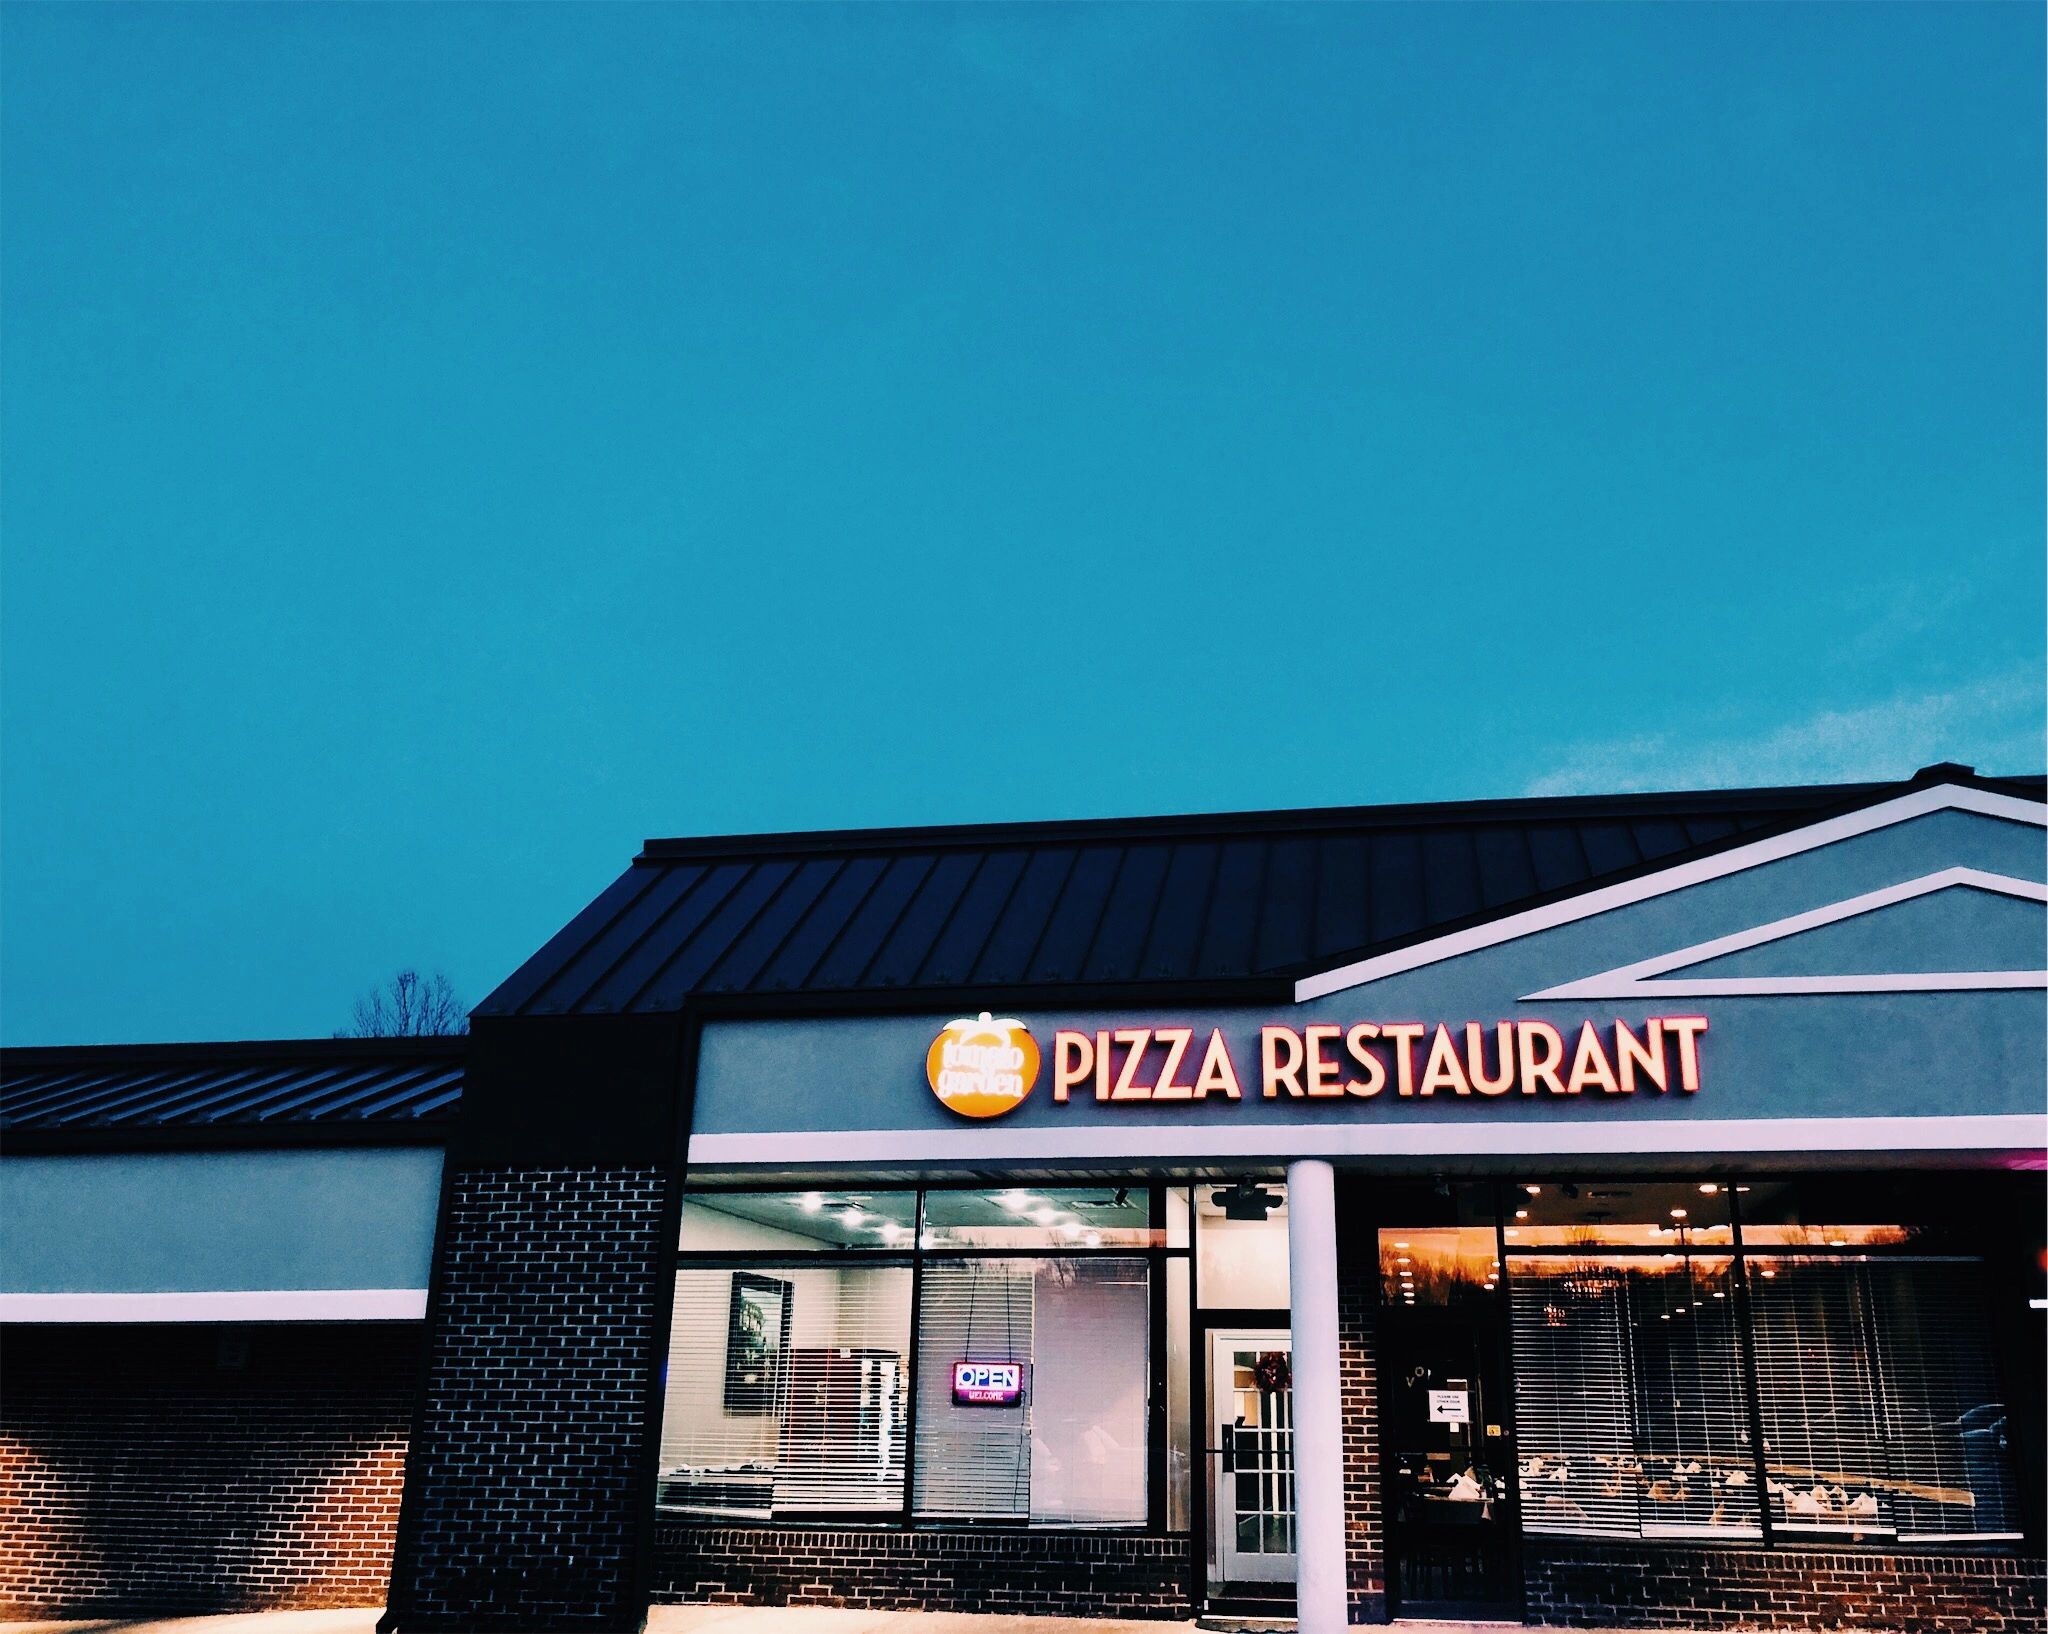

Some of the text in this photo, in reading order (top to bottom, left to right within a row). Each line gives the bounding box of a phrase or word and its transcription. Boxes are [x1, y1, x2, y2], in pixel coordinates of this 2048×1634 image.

[1053, 1015, 1709, 1101] PIZZA RESTAURANT
[959, 1368, 1015, 1387] OPEN
[969, 1391, 1004, 1400] WELCOME
